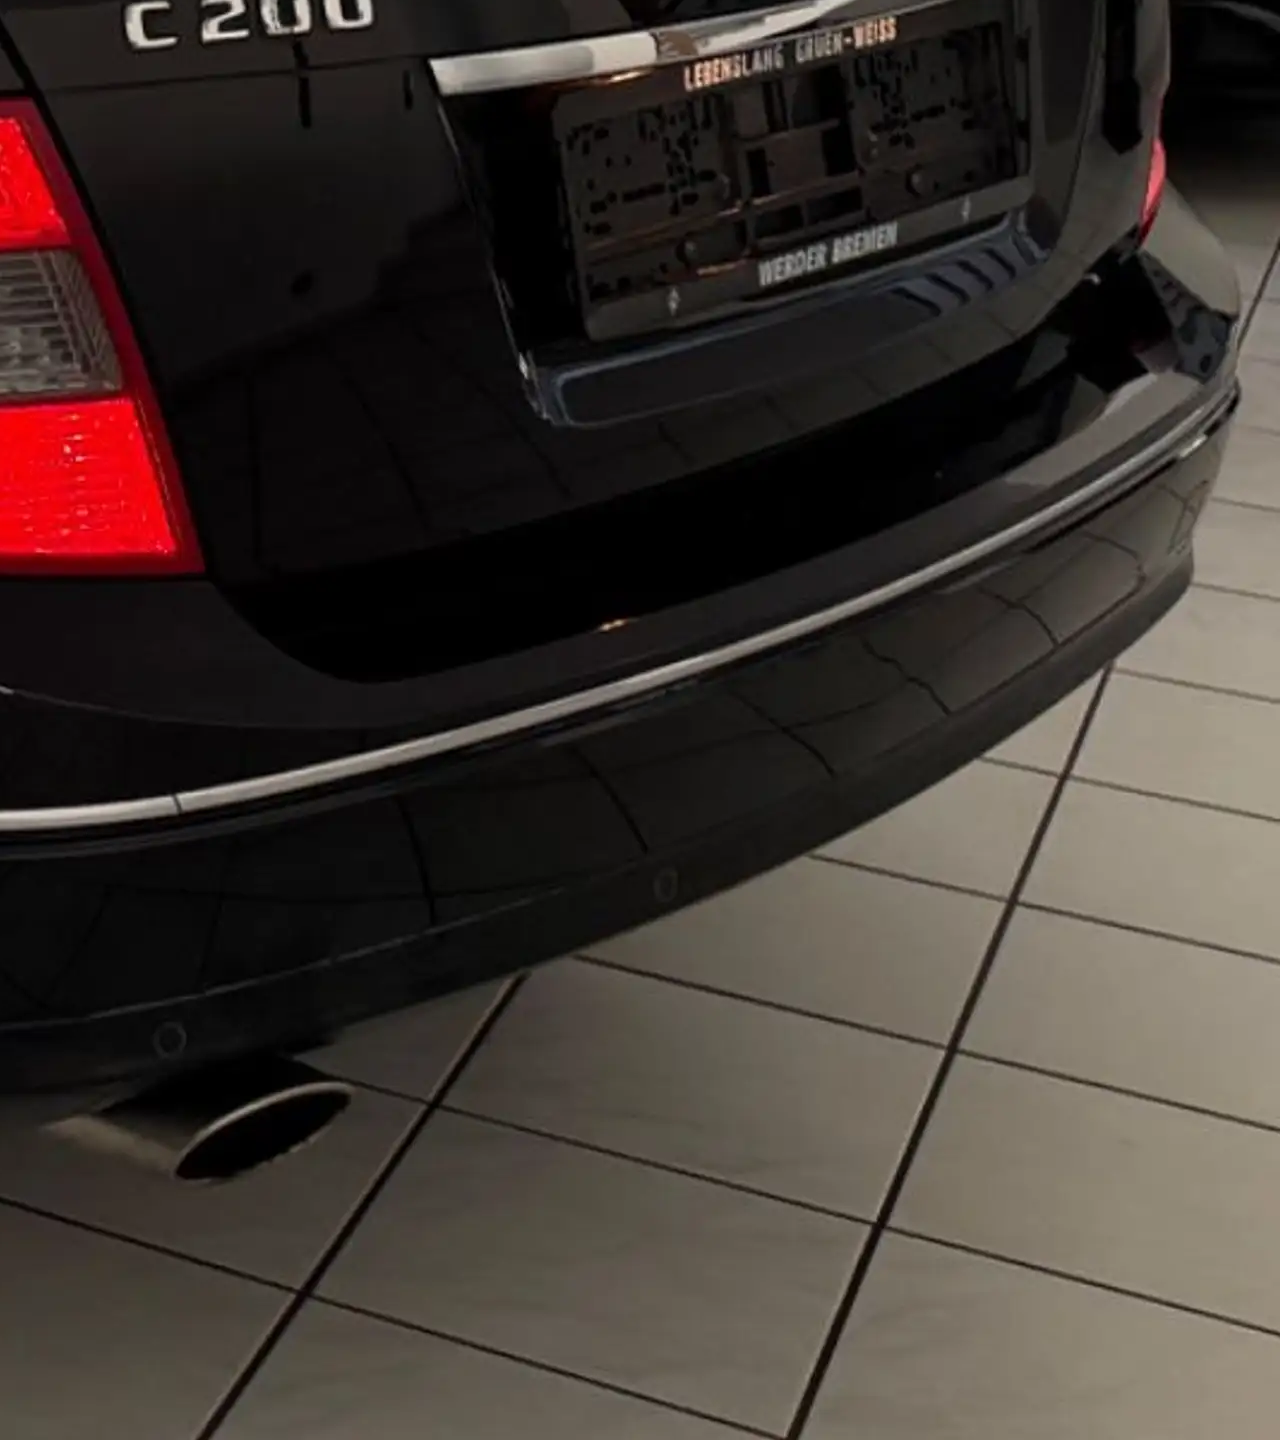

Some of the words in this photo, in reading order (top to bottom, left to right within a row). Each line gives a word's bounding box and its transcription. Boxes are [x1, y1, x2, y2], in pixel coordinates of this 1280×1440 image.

[123, 0, 179, 51] C
[683, 44, 785, 93] LEBENSLANG
[758, 241, 828, 287] WERDER
[831, 220, 898, 264] BREMEN
